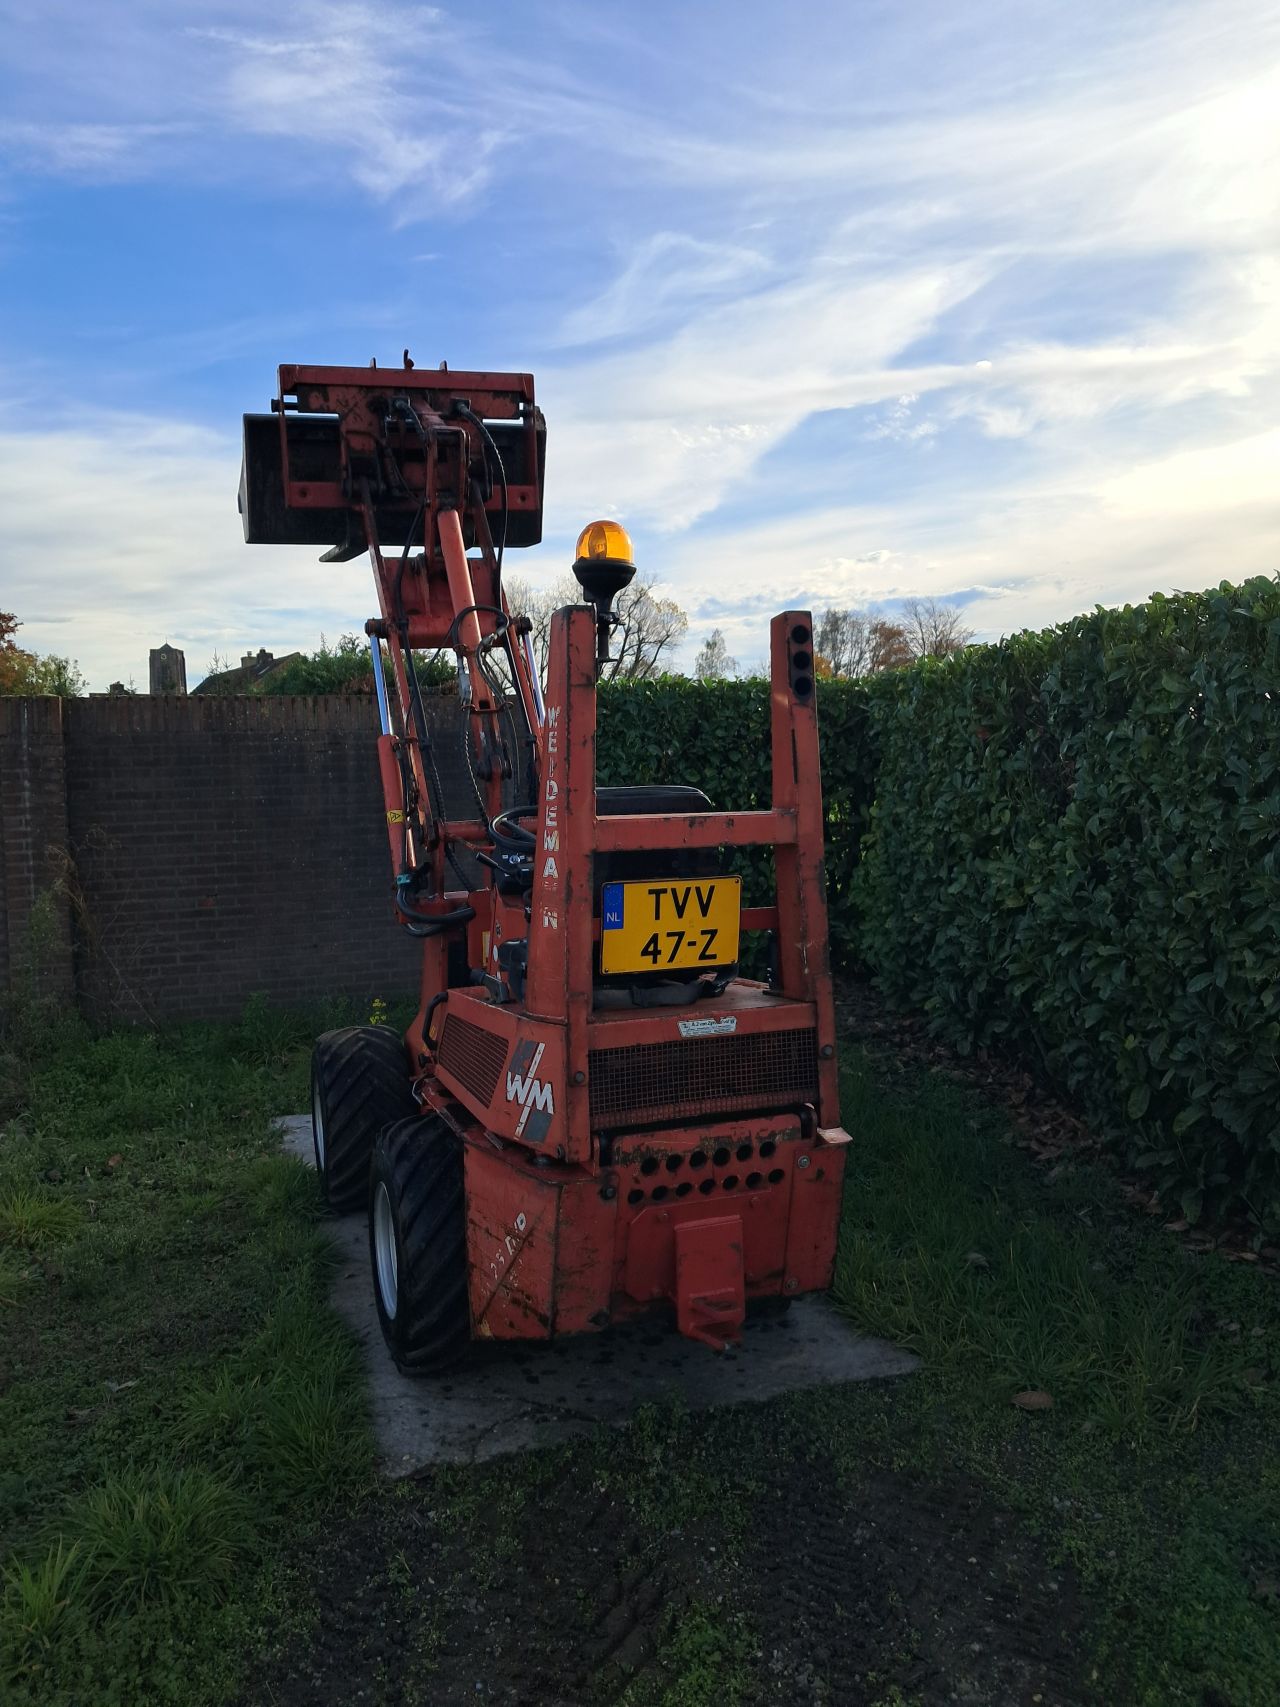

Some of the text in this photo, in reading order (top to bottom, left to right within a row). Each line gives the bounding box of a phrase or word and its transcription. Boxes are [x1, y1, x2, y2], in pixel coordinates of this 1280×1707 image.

[606, 912, 621, 923] NL
[648, 884, 716, 921] TVV
[640, 928, 719, 965] 47-Z
